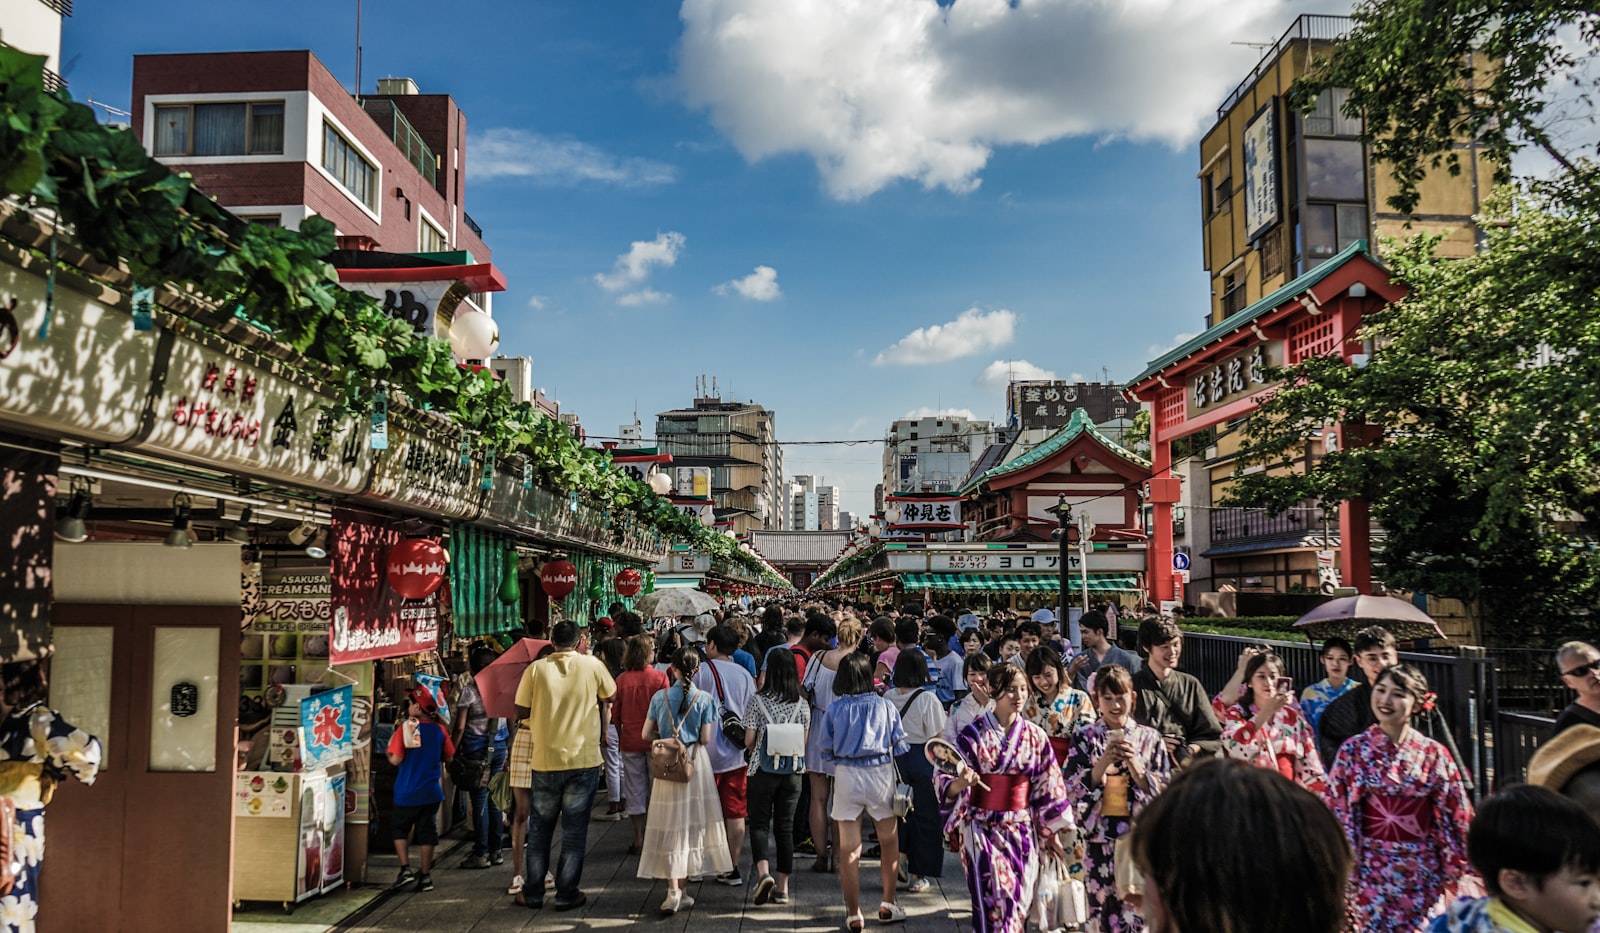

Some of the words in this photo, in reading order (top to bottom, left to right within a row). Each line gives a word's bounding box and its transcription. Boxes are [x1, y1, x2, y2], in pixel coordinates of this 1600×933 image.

[904, 503, 951, 522] 仲見世
[281, 575, 327, 584] ASAKUSA
[313, 705, 346, 747] 氷
